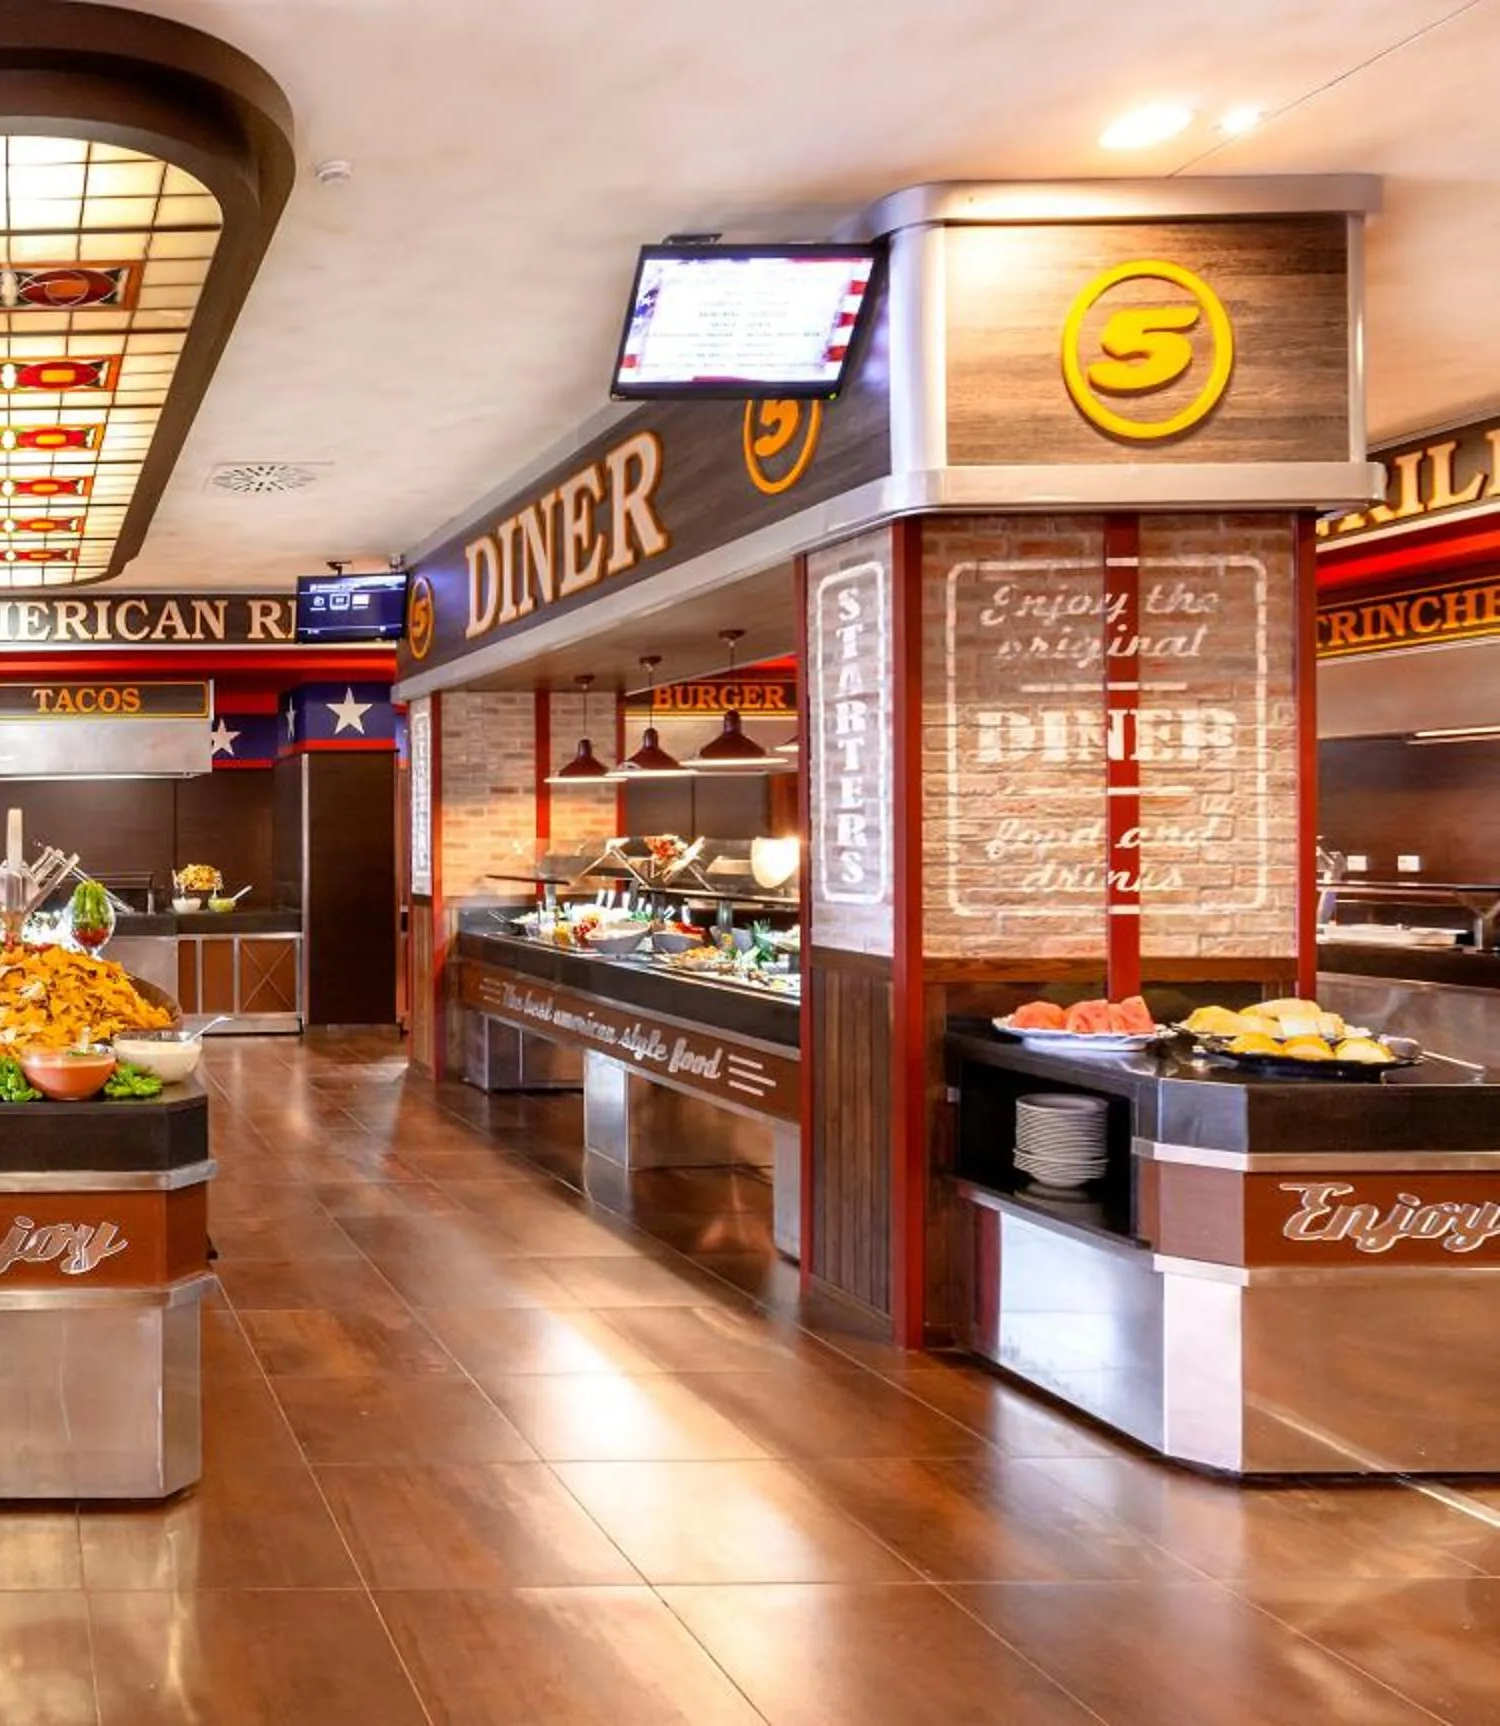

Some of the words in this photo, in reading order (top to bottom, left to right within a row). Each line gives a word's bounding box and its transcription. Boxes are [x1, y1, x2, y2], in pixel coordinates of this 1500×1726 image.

[464, 430, 671, 640] DINER
[980, 583, 1129, 626] Enjoy
[1145, 582, 1220, 615] the
[993, 624, 1209, 669] original
[32, 688, 141, 714] TACOS
[651, 684, 787, 710] BURGER
[834, 587, 868, 884] STARTERS
[973, 706, 1239, 764] DINER
[1115, 817, 1222, 849] and
[1021, 861, 1185, 893] drinks
[618, 1022, 669, 1061] style
[667, 1037, 723, 1080] food
[1278, 1181, 1500, 1254] Enjoy
